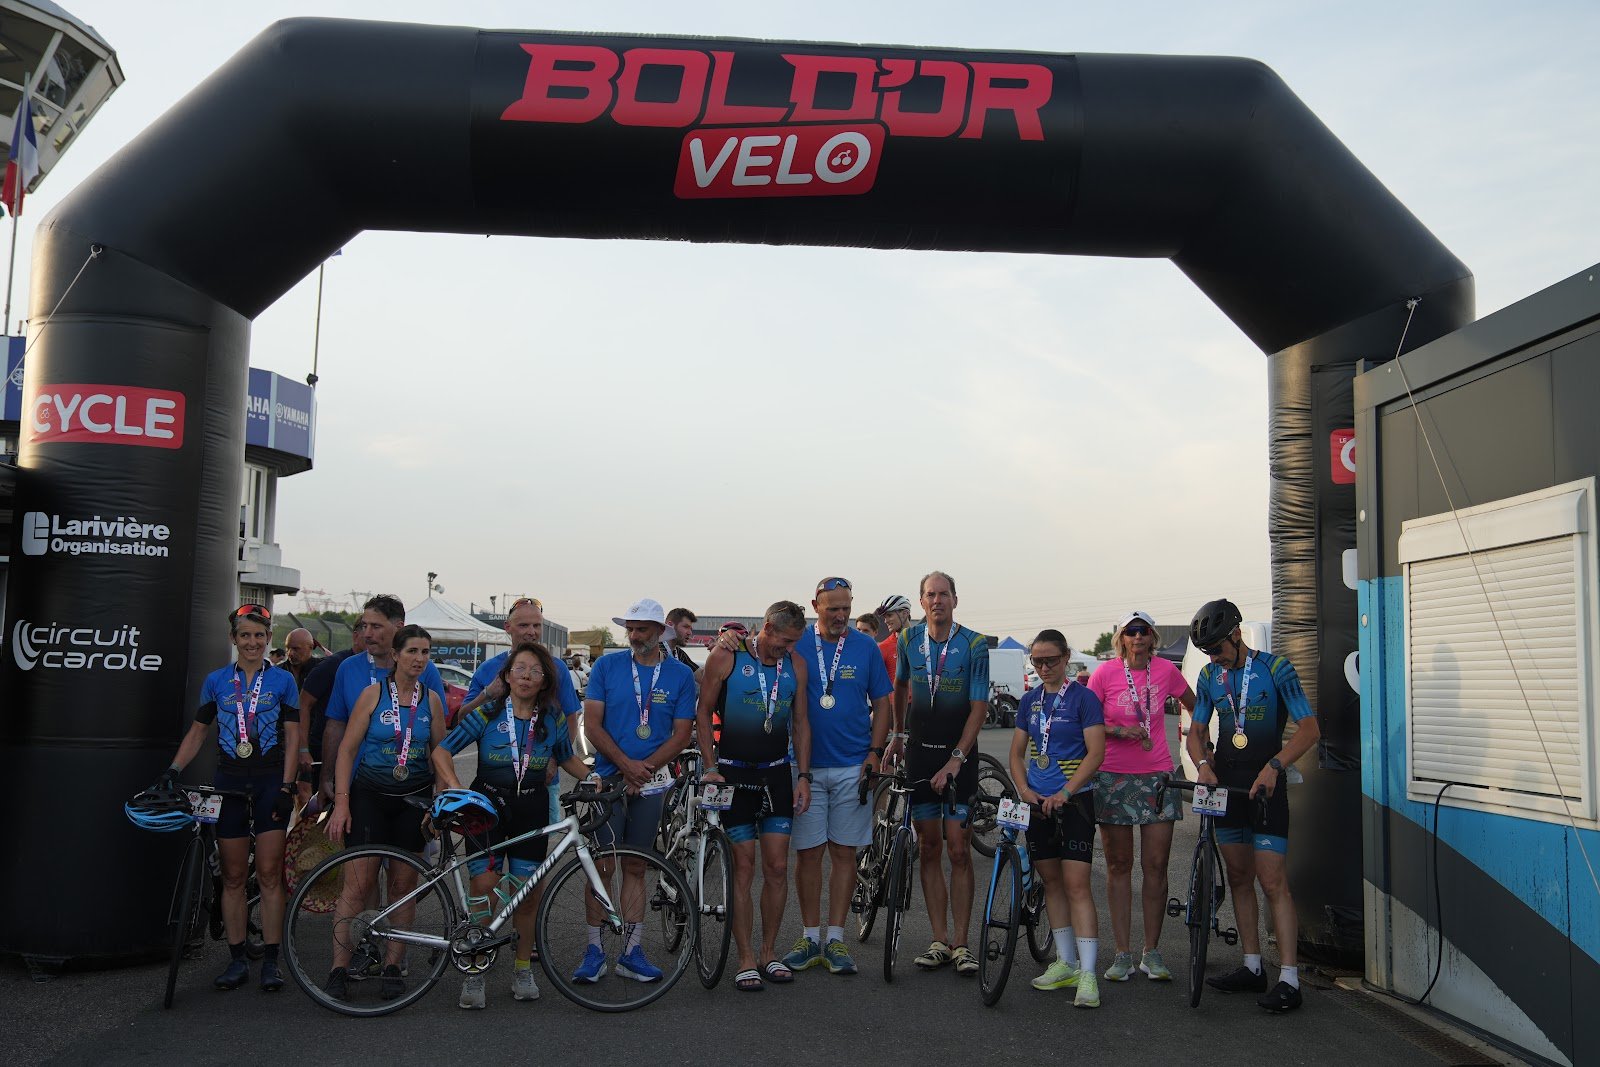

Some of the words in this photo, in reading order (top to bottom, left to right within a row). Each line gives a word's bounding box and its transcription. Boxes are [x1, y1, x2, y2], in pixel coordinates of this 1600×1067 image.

[689, 131, 872, 188] VELO
[32, 393, 176, 439] CYCLE
[283, 405, 309, 427] YAMAHA
[52, 515, 170, 541] Larivière
[51, 538, 169, 557] Organisation
[30, 622, 141, 647] circuit
[42, 649, 163, 672] carole
[430, 644, 483, 656] carole
[1197, 798, 1221, 807] 315-1
[1002, 811, 1025, 821] 314-1
